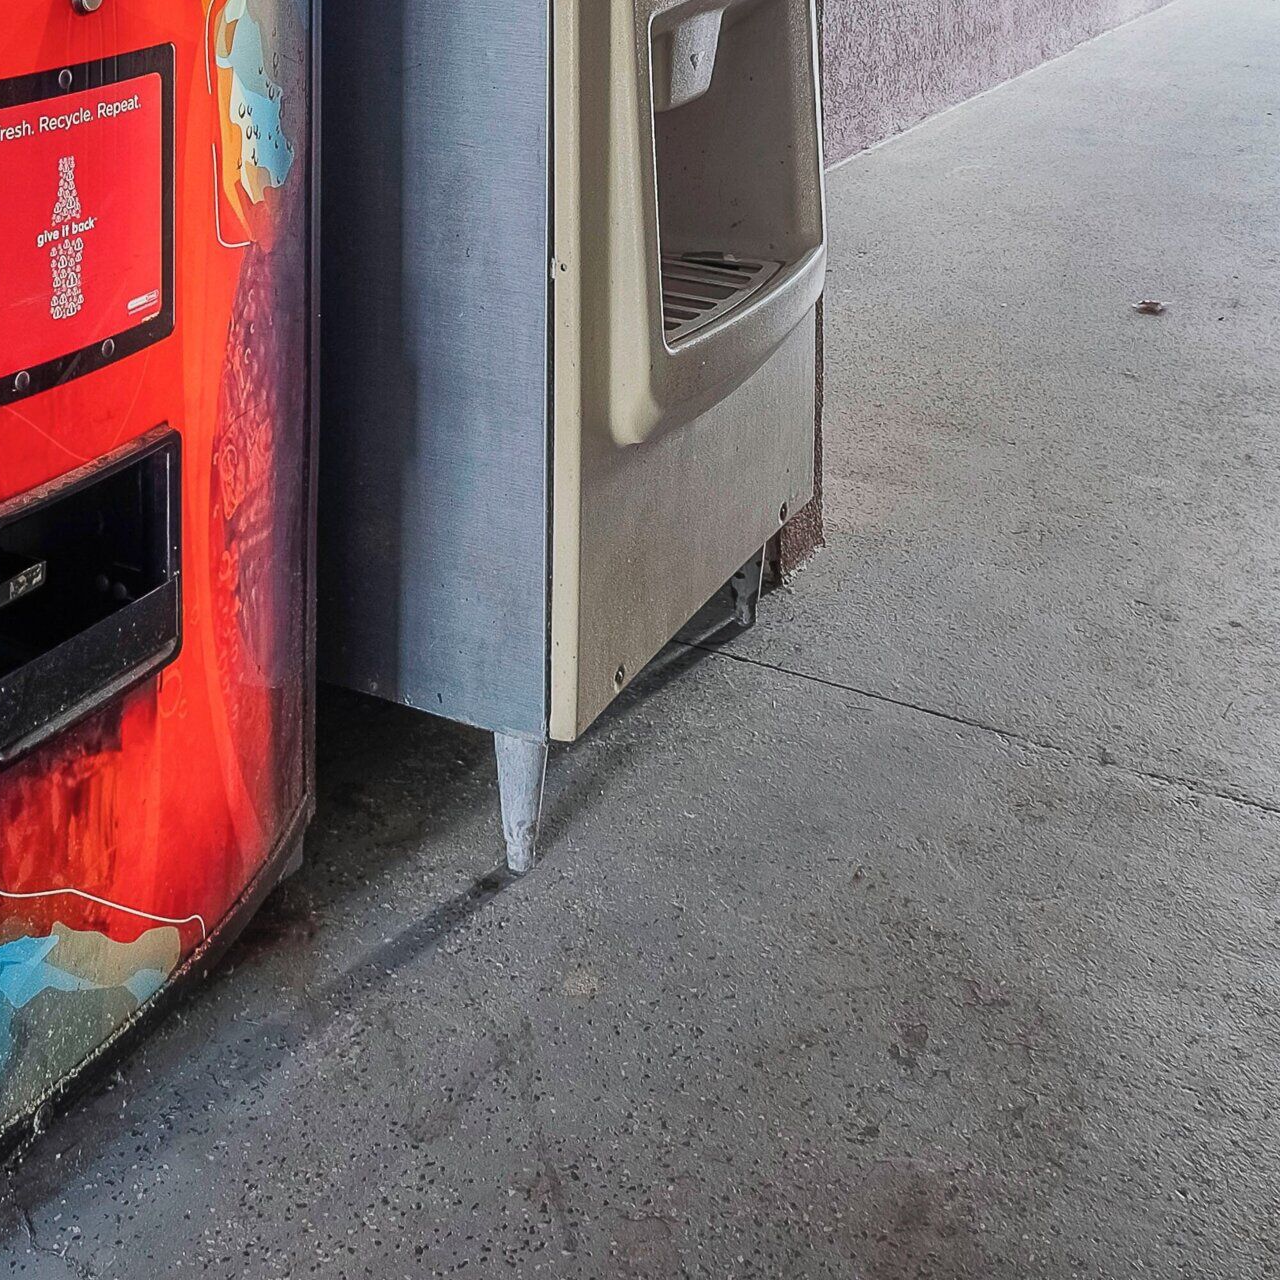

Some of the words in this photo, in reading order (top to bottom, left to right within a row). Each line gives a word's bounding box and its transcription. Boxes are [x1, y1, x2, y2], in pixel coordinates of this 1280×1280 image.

[39, 107, 94, 133] Recycle.
[97, 94, 142, 118] Repeat.
[37, 230, 59, 248] give
[62, 224, 69, 237] it
[71, 217, 95, 234] back
